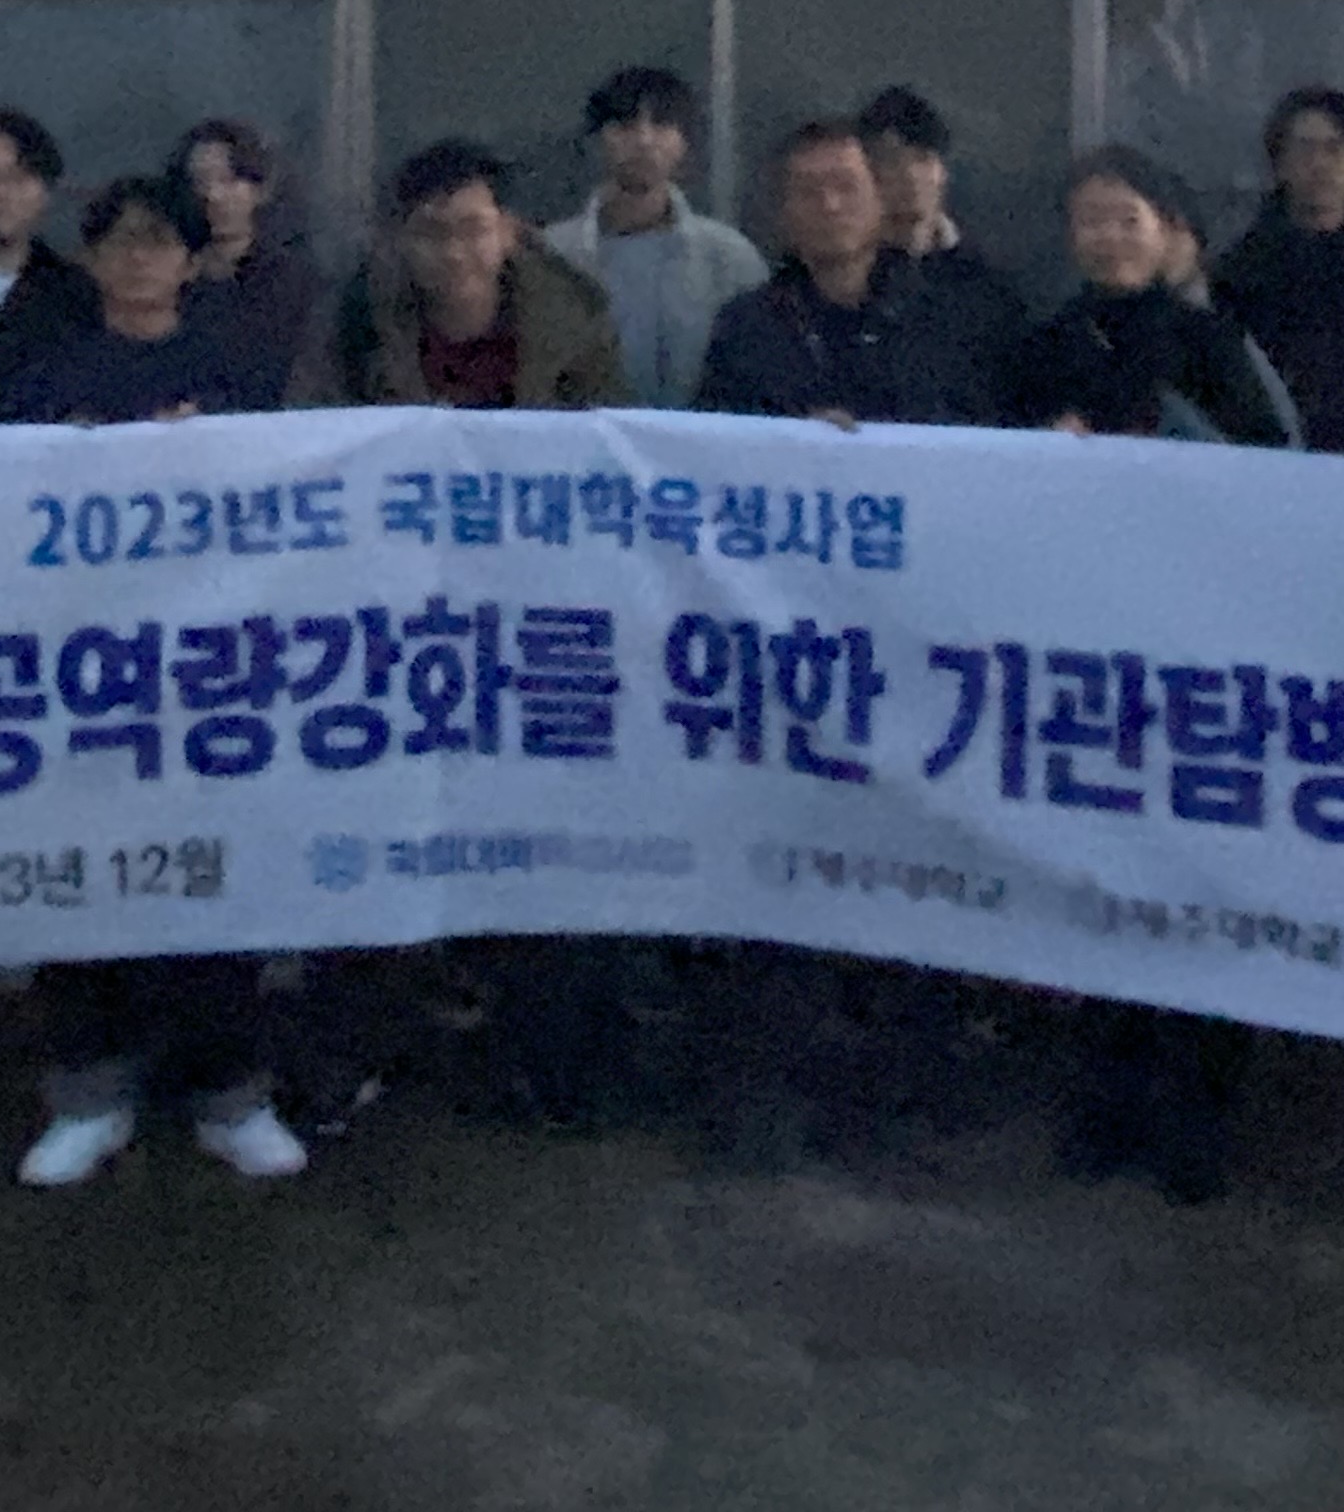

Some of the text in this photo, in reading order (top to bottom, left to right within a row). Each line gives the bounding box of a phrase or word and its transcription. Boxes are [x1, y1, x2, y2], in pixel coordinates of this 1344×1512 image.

[28, 471, 904, 570] 2023년도 국립대학육성사업
[662, 612, 884, 782] 위한
